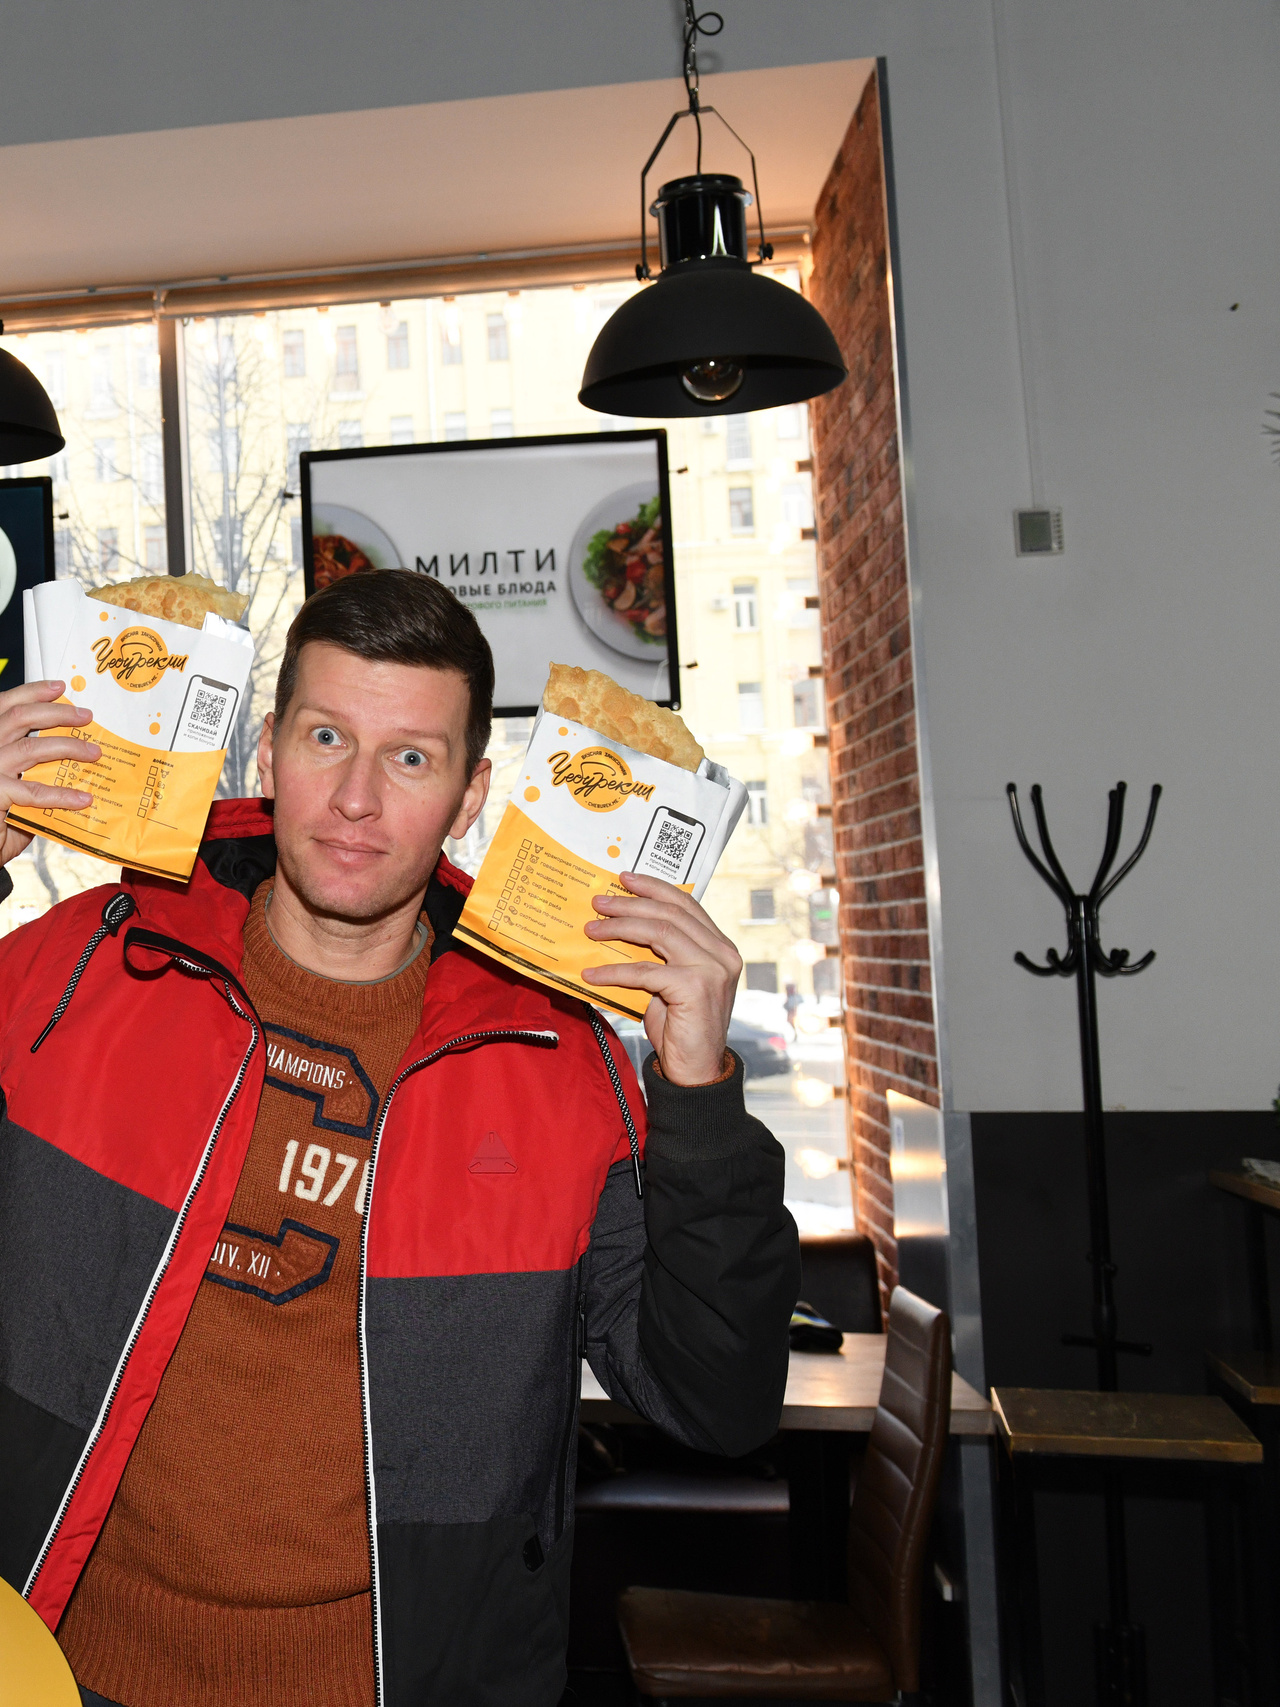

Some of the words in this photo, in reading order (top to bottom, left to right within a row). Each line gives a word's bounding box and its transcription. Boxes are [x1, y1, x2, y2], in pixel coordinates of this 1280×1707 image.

[416, 548, 556, 577] МИЛТИ
[498, 581, 557, 596] БЛЮДА
[187, 722, 218, 736] СКАЧИВАЙ
[650, 852, 680, 869] СКАЧИВАЙ
[267, 1043, 346, 1089] HAMPIONS
[247, 1250, 271, 1279] XII
